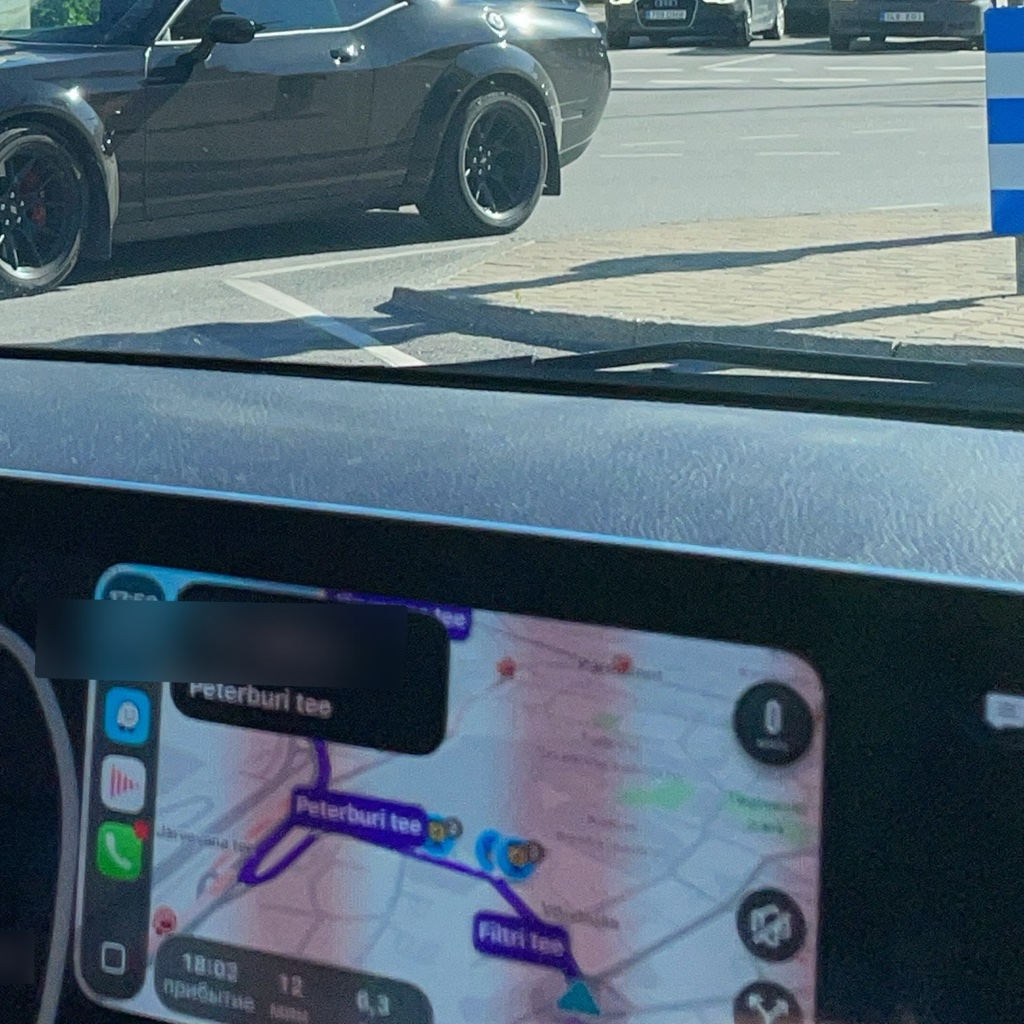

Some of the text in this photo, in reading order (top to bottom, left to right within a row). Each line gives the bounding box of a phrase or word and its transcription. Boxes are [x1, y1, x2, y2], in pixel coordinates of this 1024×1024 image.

[295, 691, 333, 719] tee
[295, 796, 422, 836] Peterburi tee
[478, 918, 525, 950] Filtri
